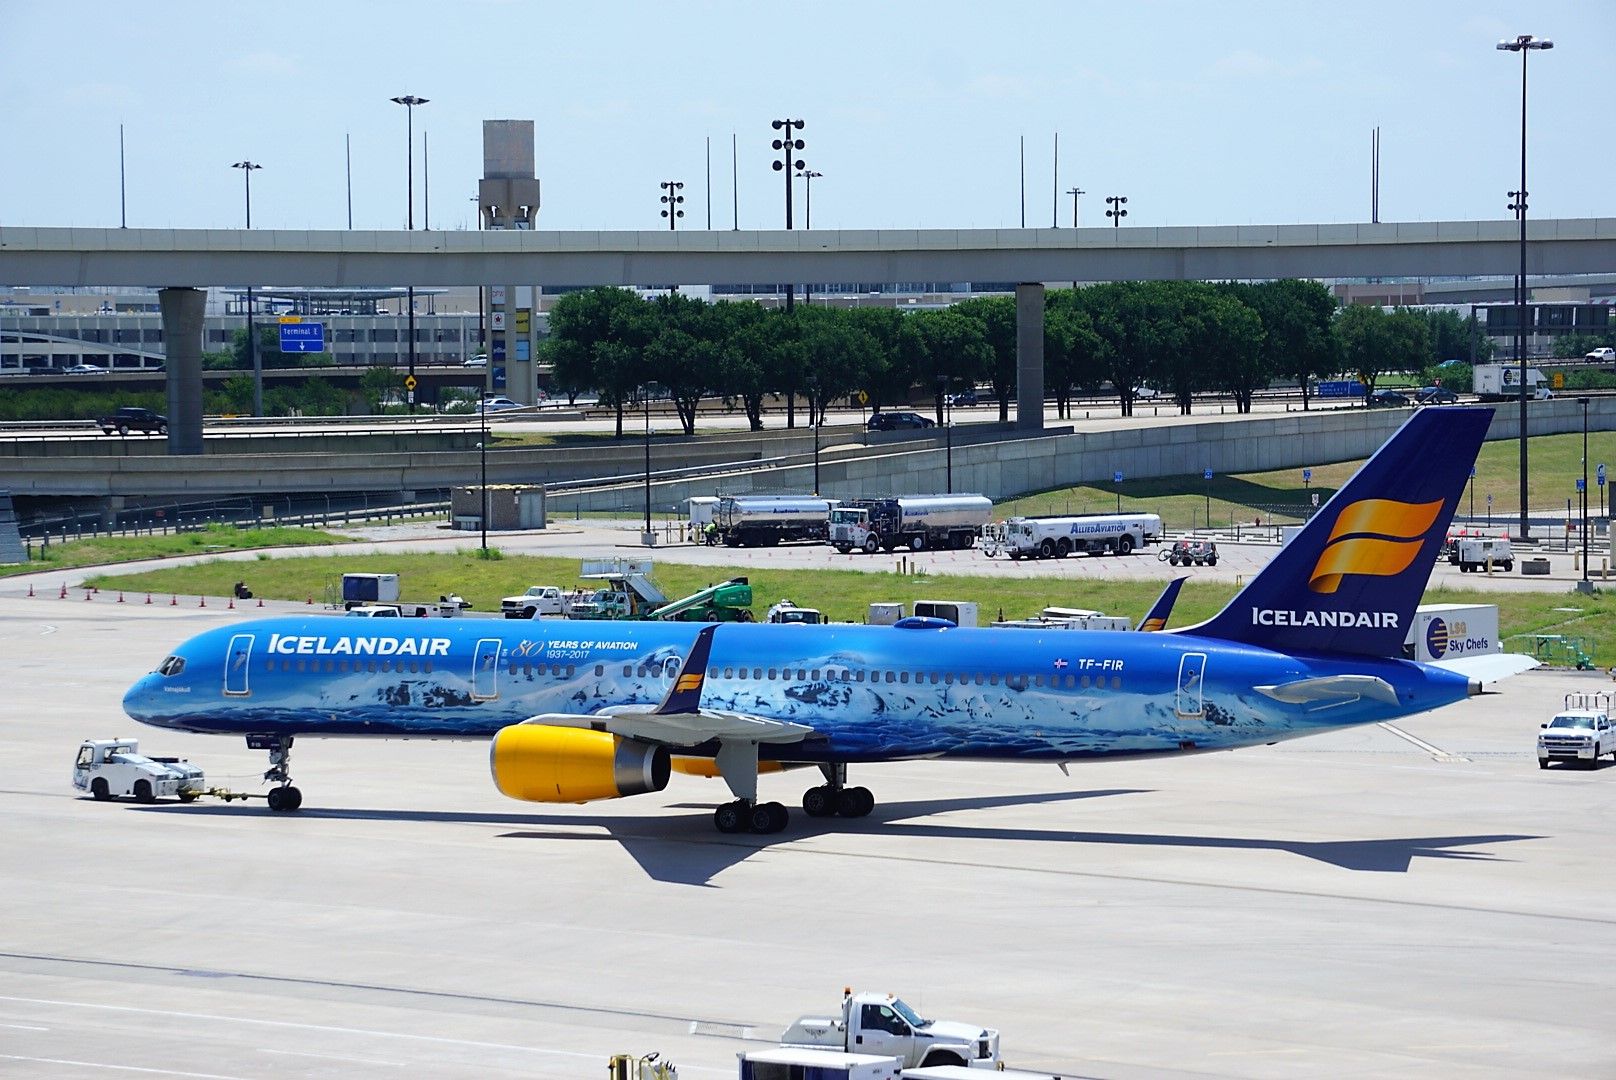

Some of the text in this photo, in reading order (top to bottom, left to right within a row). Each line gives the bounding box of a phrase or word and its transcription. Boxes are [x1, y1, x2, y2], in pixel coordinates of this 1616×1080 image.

[283, 327, 311, 335] Terminal
[1252, 606, 1399, 629] ICELANDAIR
[267, 633, 452, 656] ICELANDAIR
[547, 640, 579, 650] YEARS
[580, 641, 594, 650] OF
[595, 641, 639, 651] AVIATION
[1449, 637, 1489, 653] Sky Chefs
[1079, 658, 1124, 671] TF-FIR
